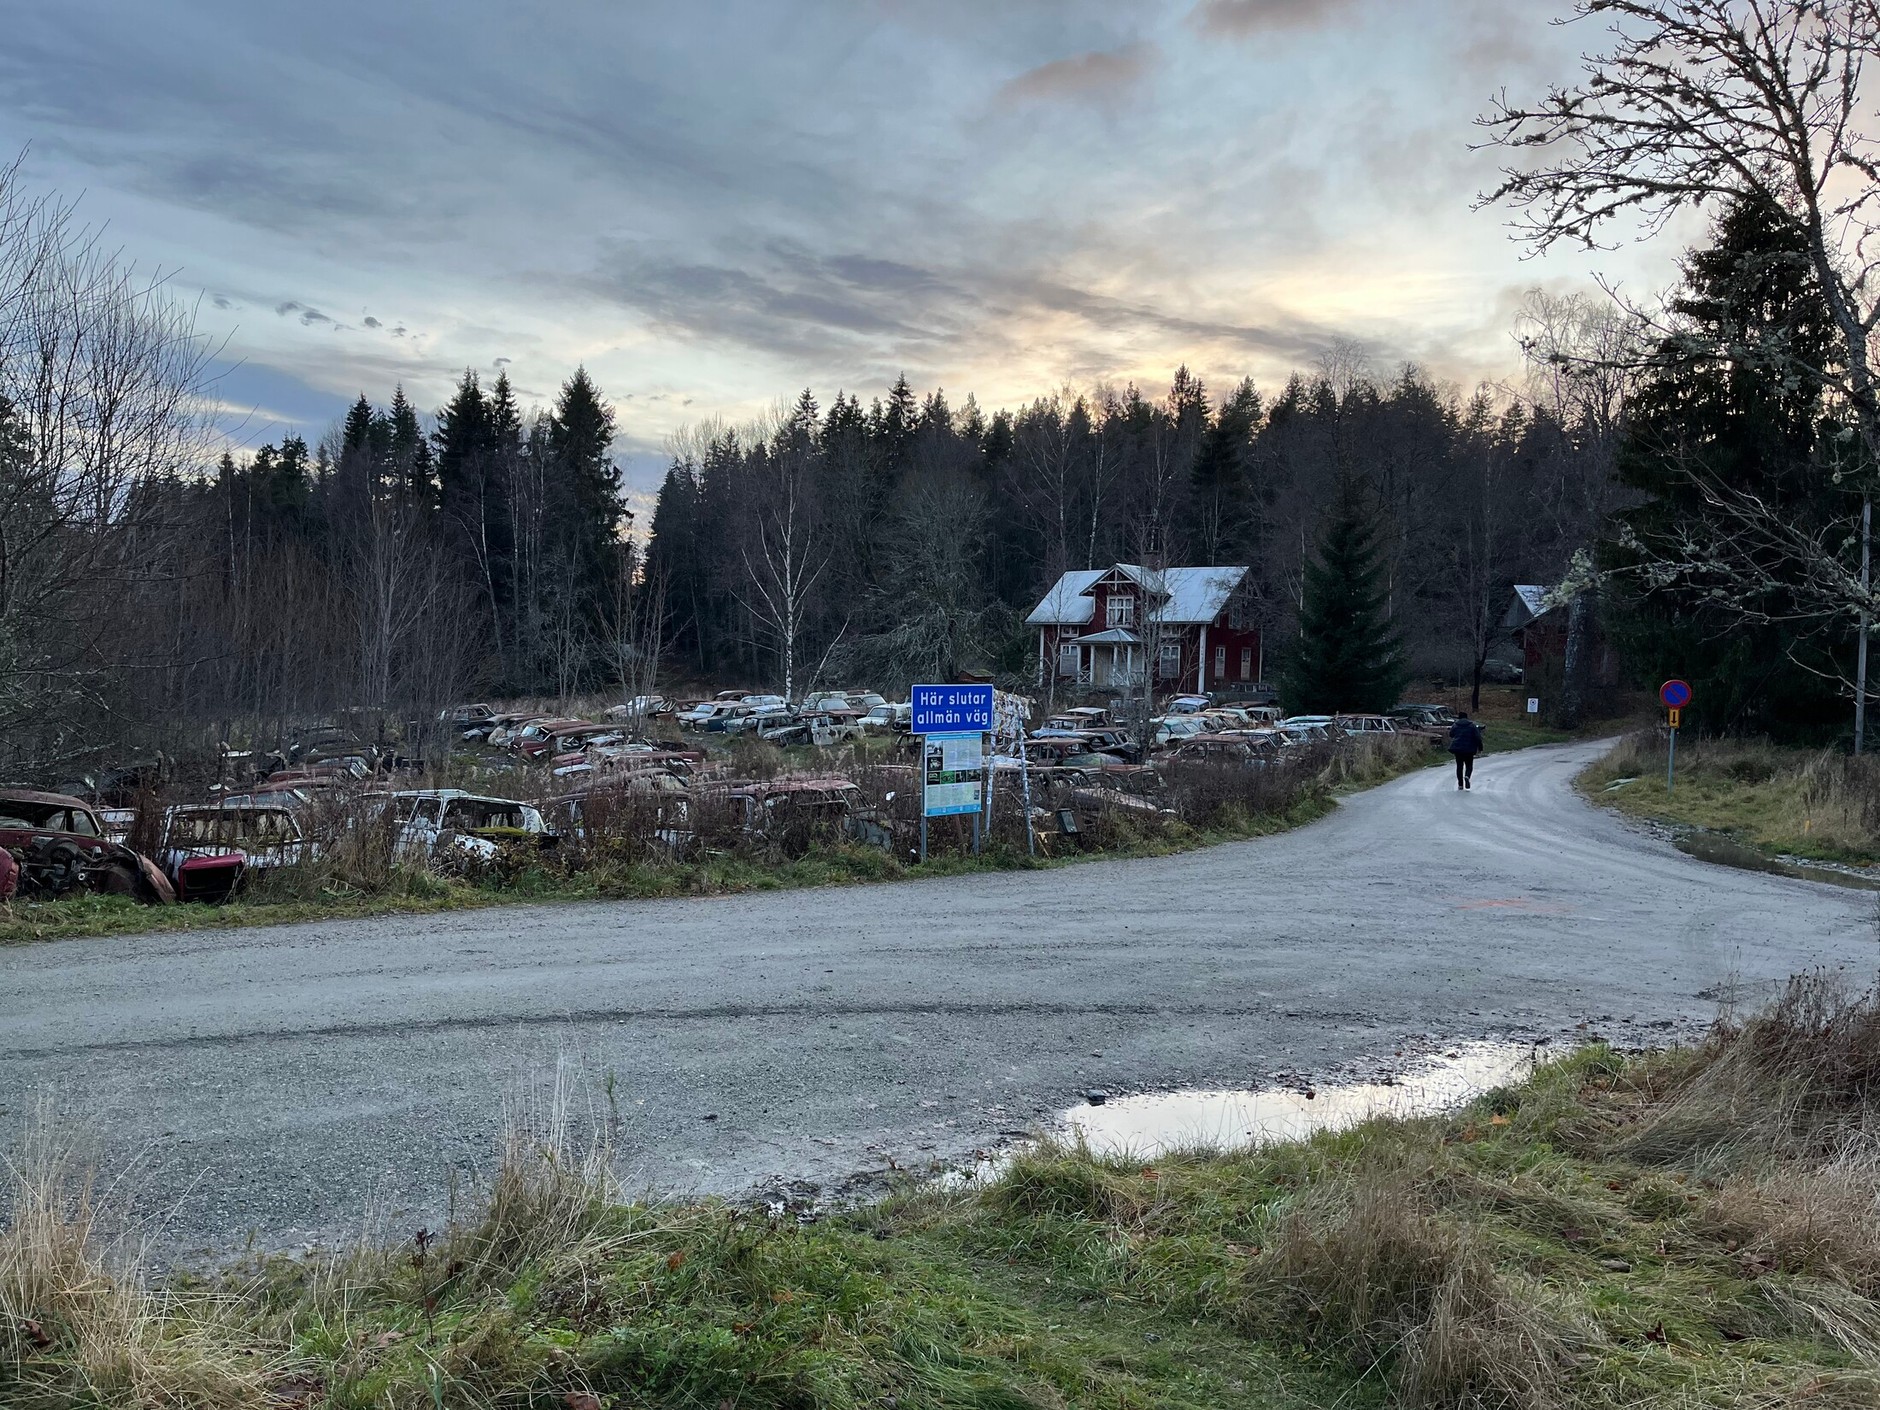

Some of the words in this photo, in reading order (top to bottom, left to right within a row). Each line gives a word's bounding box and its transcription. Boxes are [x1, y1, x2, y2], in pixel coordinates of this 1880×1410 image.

[920, 692, 943, 706] Här
[948, 691, 986, 705] slutar
[917, 710, 960, 725] allmän
[966, 709, 988, 725] väg
